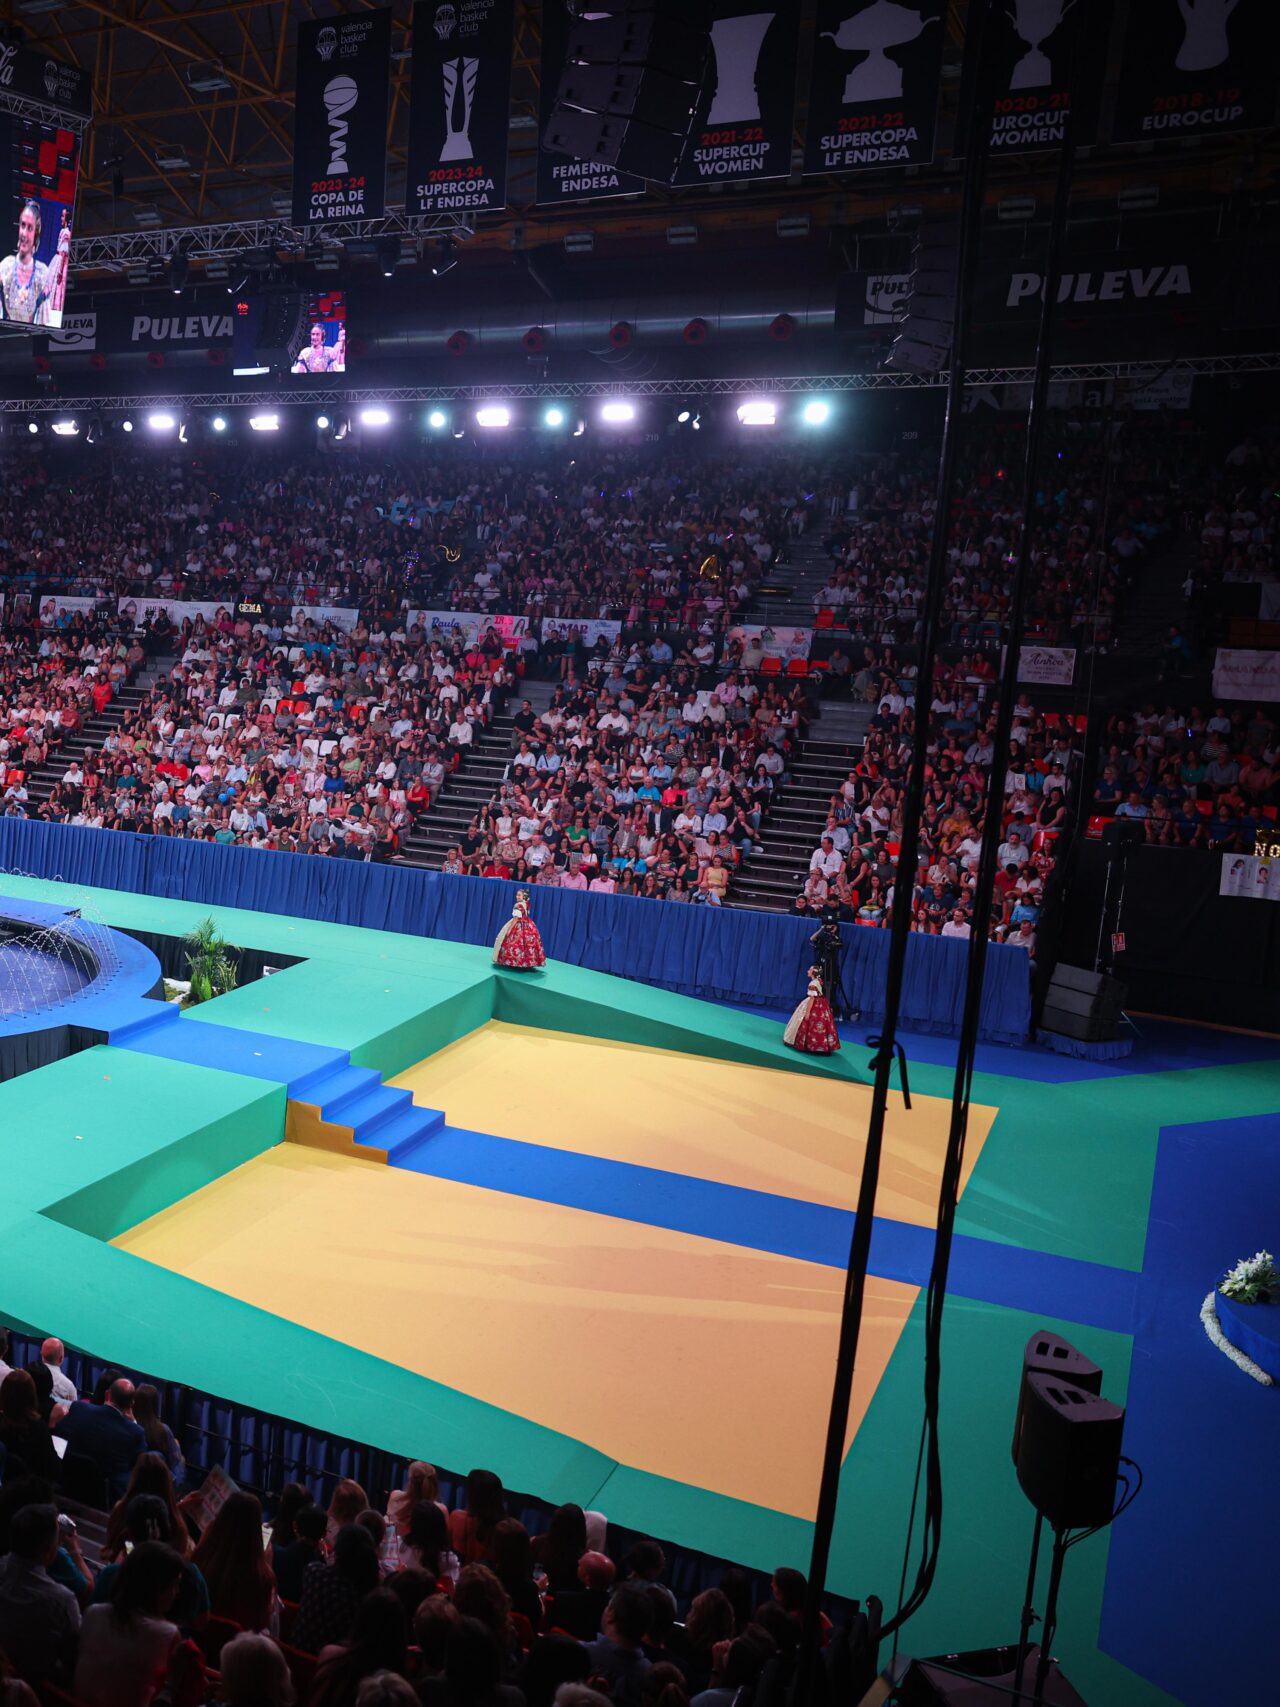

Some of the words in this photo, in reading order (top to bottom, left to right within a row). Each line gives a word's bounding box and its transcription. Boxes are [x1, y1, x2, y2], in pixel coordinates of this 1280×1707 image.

[460, 11, 488, 23] basket
[341, 20, 373, 33] valencia
[459, 22, 479, 34] club
[340, 32, 367, 45] basket
[340, 43, 359, 54] club
[837, 112, 904, 132] 2021-22
[1142, 105, 1244, 131] EUROCUP
[701, 128, 765, 146] 2021-22
[821, 127, 919, 150] SUPERCOPA
[693, 142, 770, 163] SUPERCUP
[825, 152, 842, 167] LF
[845, 146, 910, 164] ENDESA
[428, 165, 484, 182] 2023-24
[698, 158, 764, 176] WOMEN
[311, 176, 366, 193] 2023-24
[416, 178, 495, 197] SUPERCOPA
[561, 174, 619, 193] ENDESA
[311, 192, 345, 206] COPA
[348, 189, 364, 202] DE
[420, 198, 433, 210] LF
[437, 193, 489, 208] ENDESA
[309, 206, 325, 220] LA
[327, 203, 365, 218] REINA
[61, 318, 94, 330] ULEVA
[131, 315, 234, 341] PULEVA
[97, 611, 109, 620] 112
[238, 603, 262, 614] GEMA
